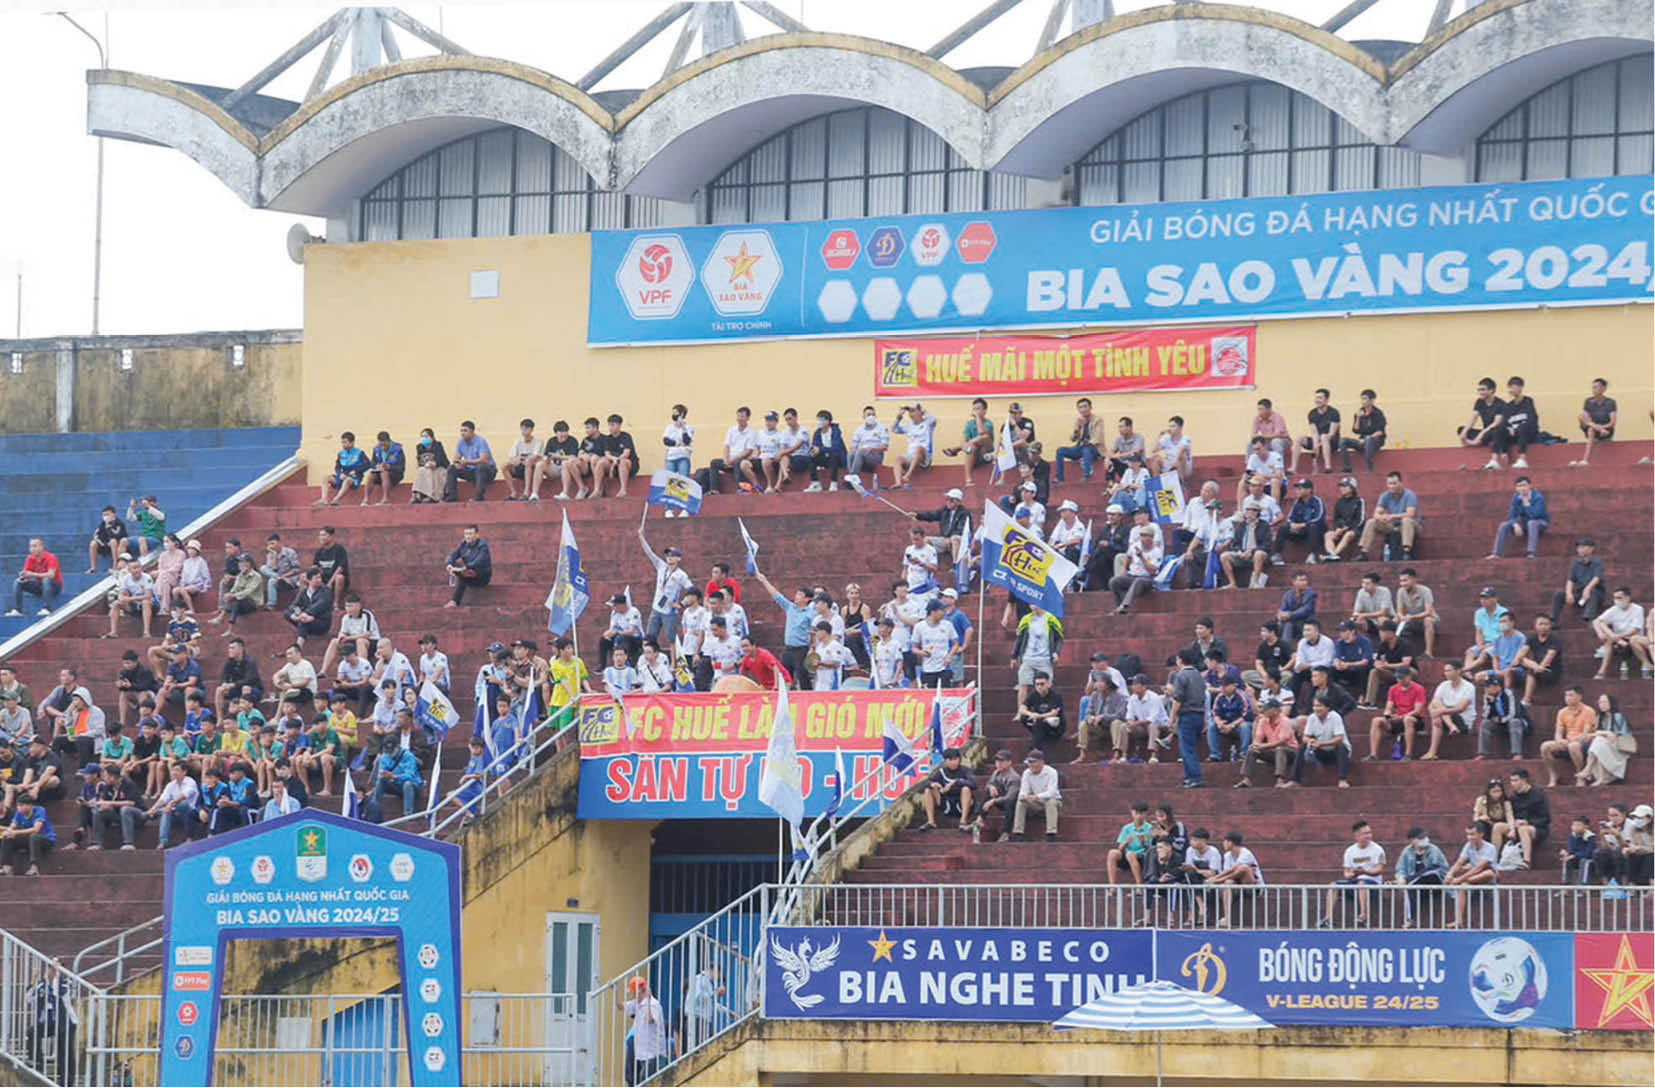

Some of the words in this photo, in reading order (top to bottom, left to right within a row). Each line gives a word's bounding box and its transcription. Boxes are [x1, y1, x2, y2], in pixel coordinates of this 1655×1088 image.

[1090, 209, 1153, 244] GIẢI
[1163, 208, 1256, 241] BÓNG
[1266, 200, 1313, 235] ĐÁ
[1324, 202, 1417, 236] HẠNG
[1428, 188, 1519, 227] NHẤT
[1529, 180, 1629, 222] QUỐC
[639, 289, 672, 304] VPF
[1027, 268, 1131, 312] BIA
[1145, 260, 1275, 307] SAO
[1292, 243, 1469, 300] VÀNG
[926, 344, 976, 384] HUẾ
[979, 346, 1026, 382] MÃI
[1032, 344, 1085, 386] MỘT
[1092, 342, 1150, 379] TÌNH
[1157, 339, 1207, 377] YÊU
[628, 707, 665, 742] FC
[671, 693, 734, 741] HUẾ
[807, 695, 857, 740] GIÓ
[701, 755, 751, 812] TỰ
[216, 910, 245, 925] BIA
[247, 909, 281, 924] SAO
[285, 904, 330, 923] VÀNG
[333, 906, 400, 924] 2024/25
[232, 890, 265, 904] BÓNG
[320, 886, 351, 901] NHẤT
[354, 886, 386, 901] QUỐC
[389, 889, 409, 900] GIA
[902, 939, 1110, 963] SAVABECO
[1258, 940, 1322, 983] BÓNG
[1328, 940, 1394, 990] ĐỘNG
[1400, 945, 1446, 991] LỰC
[839, 970, 906, 1004] BIA
[919, 971, 1035, 1006] NGHE
[1266, 994, 1368, 1010] V-LEAGUE
[1374, 994, 1440, 1011] 24/25
